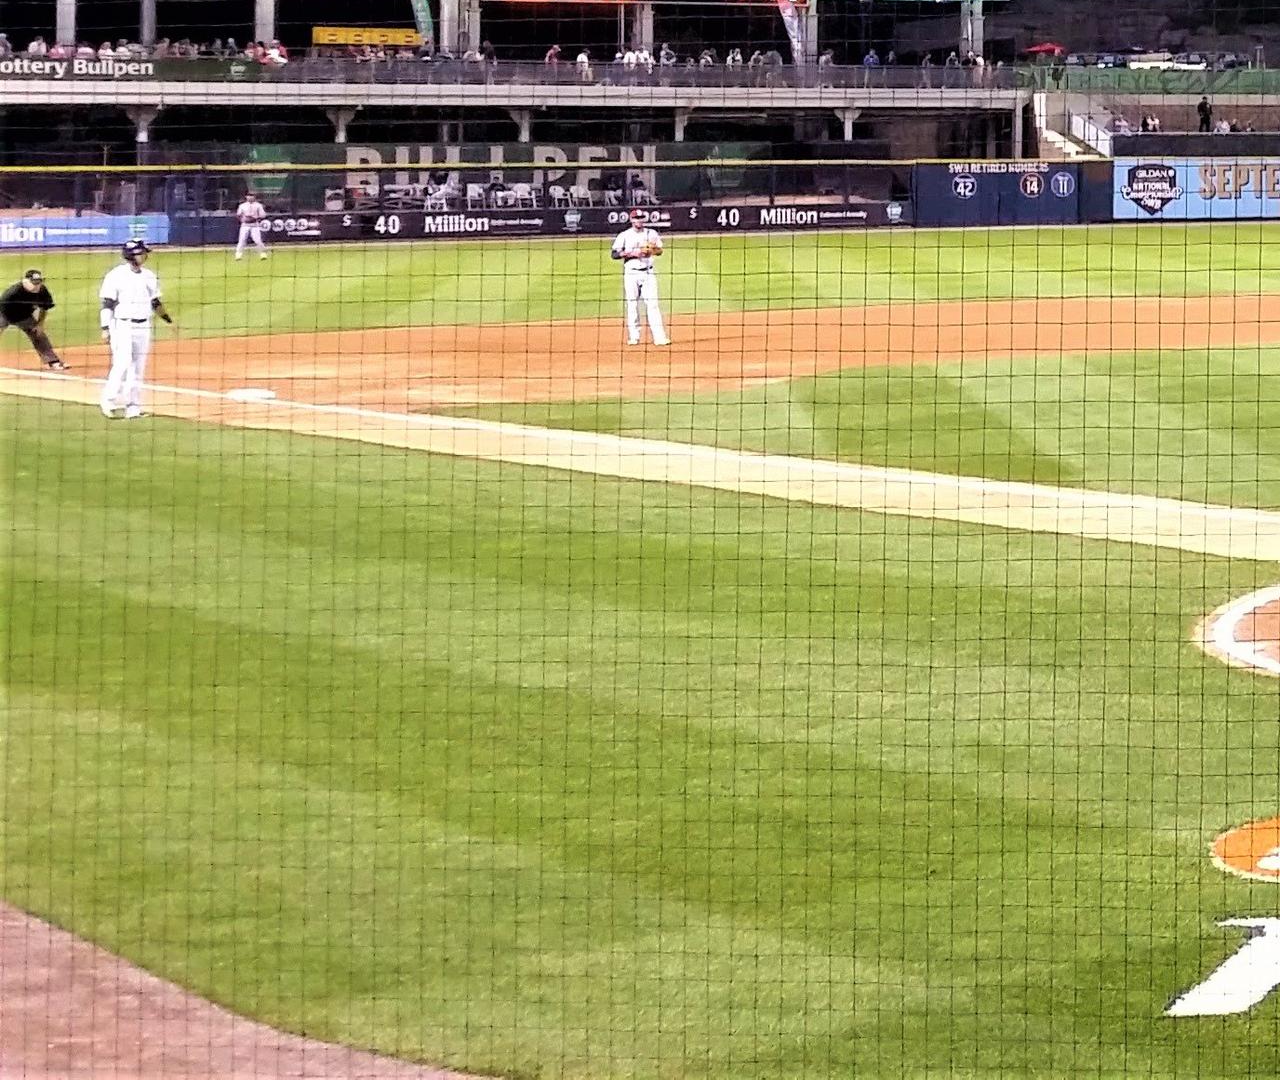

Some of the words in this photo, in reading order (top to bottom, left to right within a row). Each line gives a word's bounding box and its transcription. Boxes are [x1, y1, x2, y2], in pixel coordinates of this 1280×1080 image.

[73, 59, 154, 77] Bullpen
[970, 163, 1007, 173] RETIRED
[1008, 162, 1049, 173] NUMBERS
[956, 182, 973, 196] 42
[1026, 179, 1038, 194] 14
[374, 215, 400, 234] 40
[424, 214, 490, 233] Million
[716, 208, 740, 227] 40
[760, 207, 818, 225] Million
